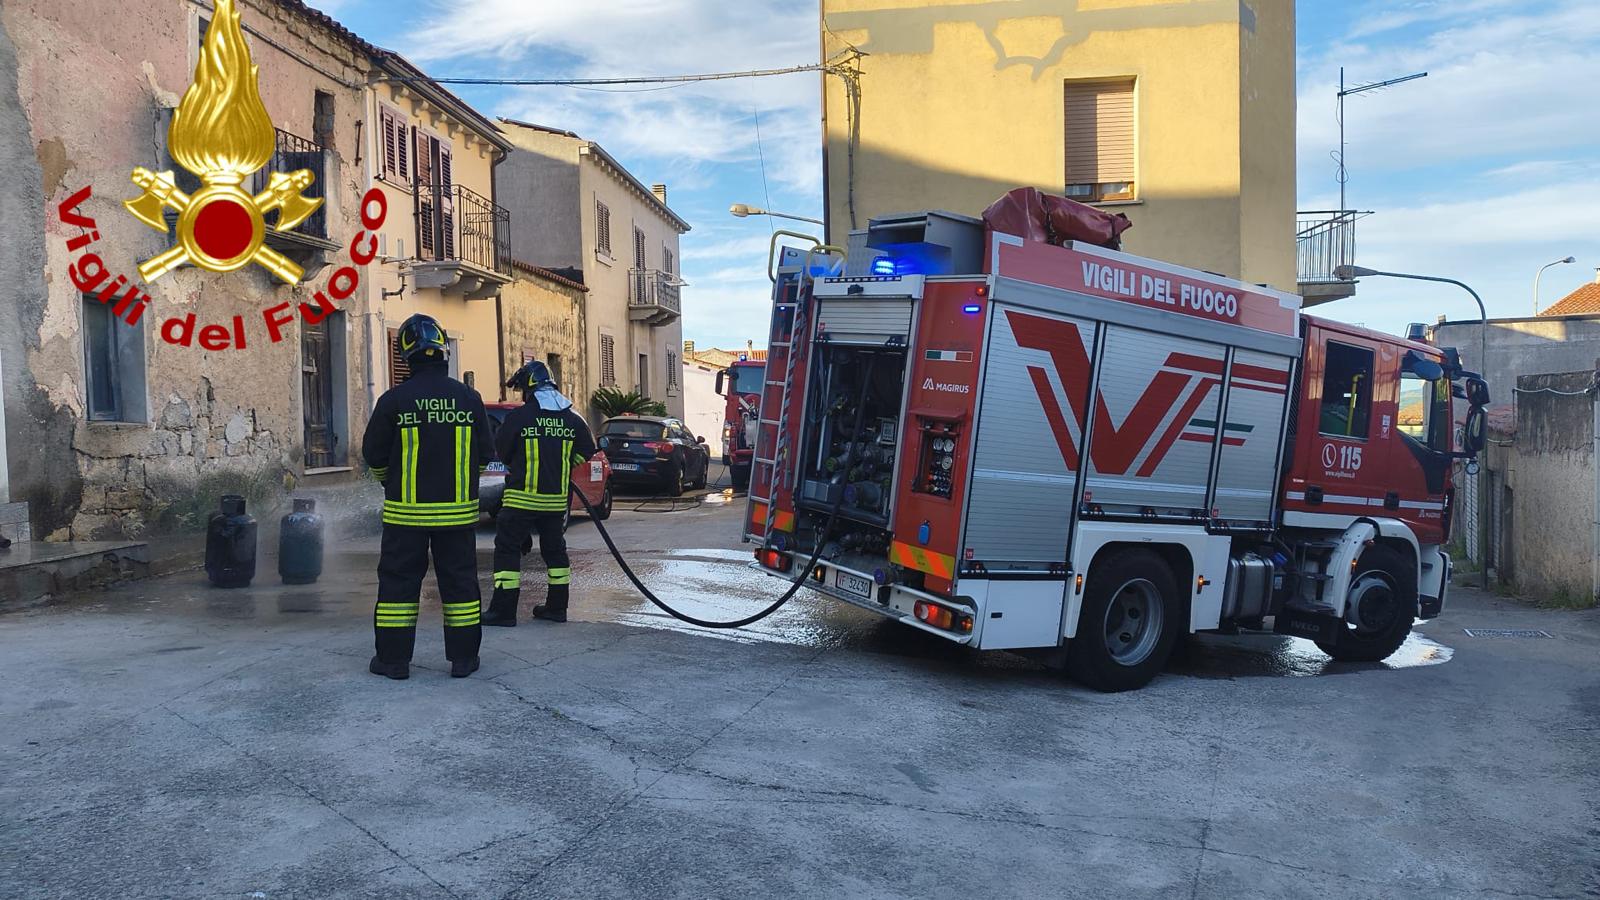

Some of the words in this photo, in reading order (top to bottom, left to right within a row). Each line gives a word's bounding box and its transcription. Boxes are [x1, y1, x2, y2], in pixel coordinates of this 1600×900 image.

[1081, 260, 1136, 297] VIGILI
[1141, 274, 1176, 305] DEL
[1180, 283, 1238, 318] FUOCO
[935, 382, 969, 394] MAGIRUS
[415, 398, 456, 411] VIGILI
[397, 411, 422, 425] DEL
[535, 417, 564, 428] VIGILI
[521, 427, 541, 437] DEL
[1340, 445, 1362, 470] 115
